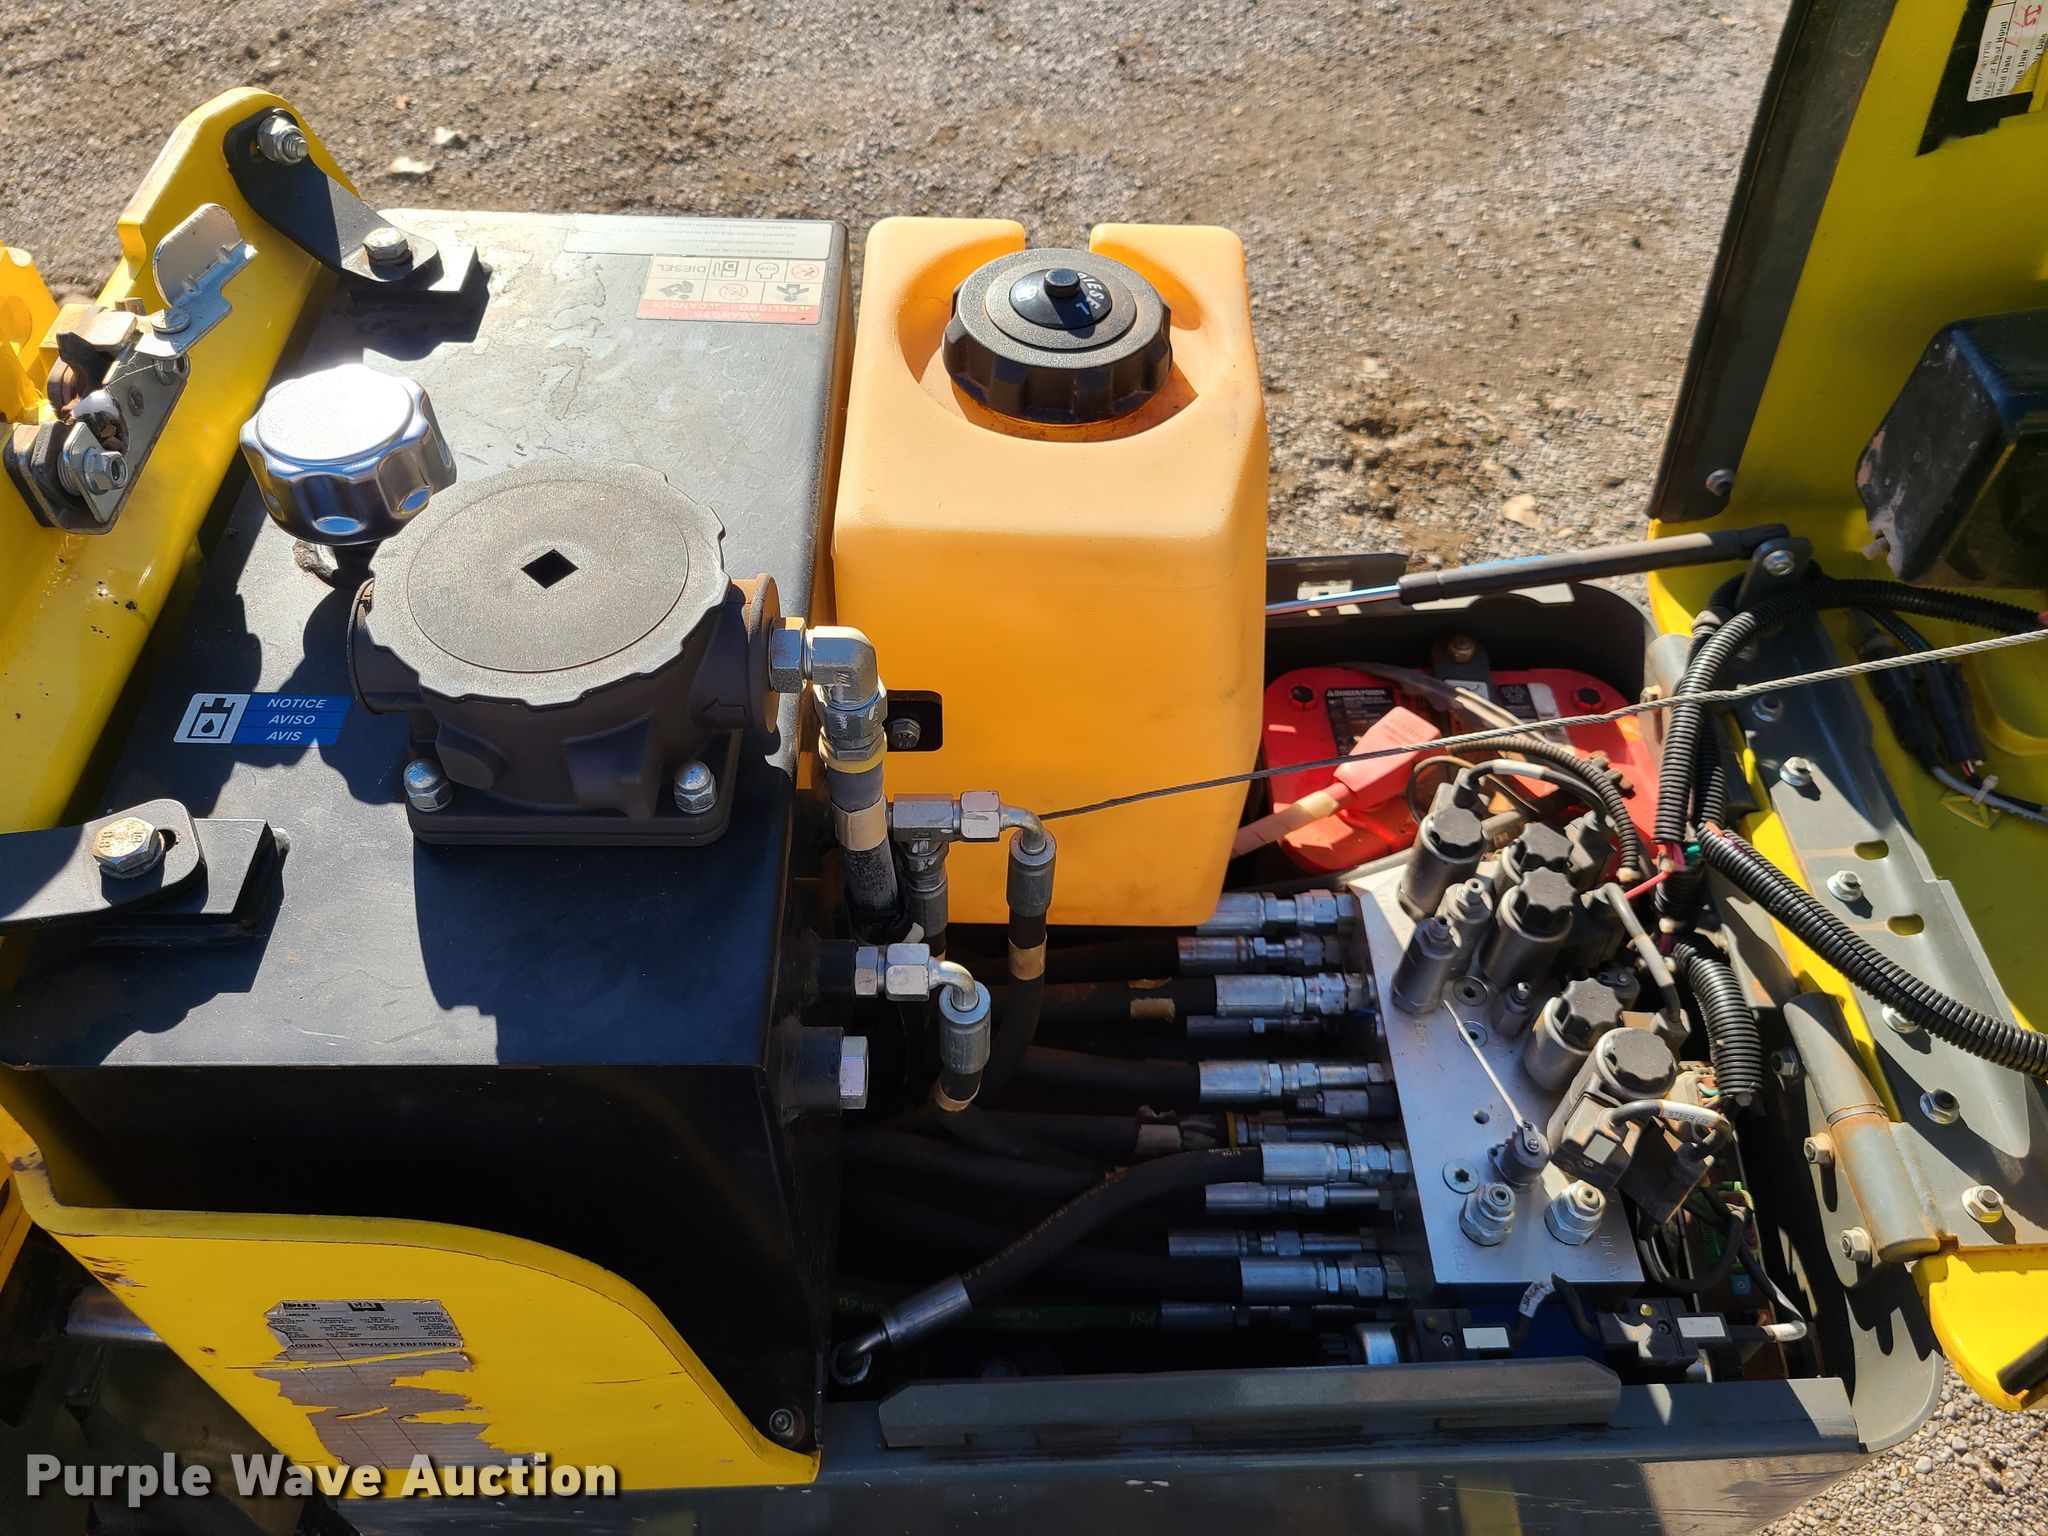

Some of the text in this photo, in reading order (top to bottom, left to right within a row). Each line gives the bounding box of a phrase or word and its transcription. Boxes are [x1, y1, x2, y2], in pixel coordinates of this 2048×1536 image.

[1995, 21, 2008, 44] Hood
[2018, 49, 2029, 68] Date
[2002, 55, 2012, 74] Date
[656, 264, 707, 273] DIESEL
[267, 698, 327, 708] NOTICE
[268, 715, 316, 725] AVISO
[266, 731, 303, 741] AVIS
